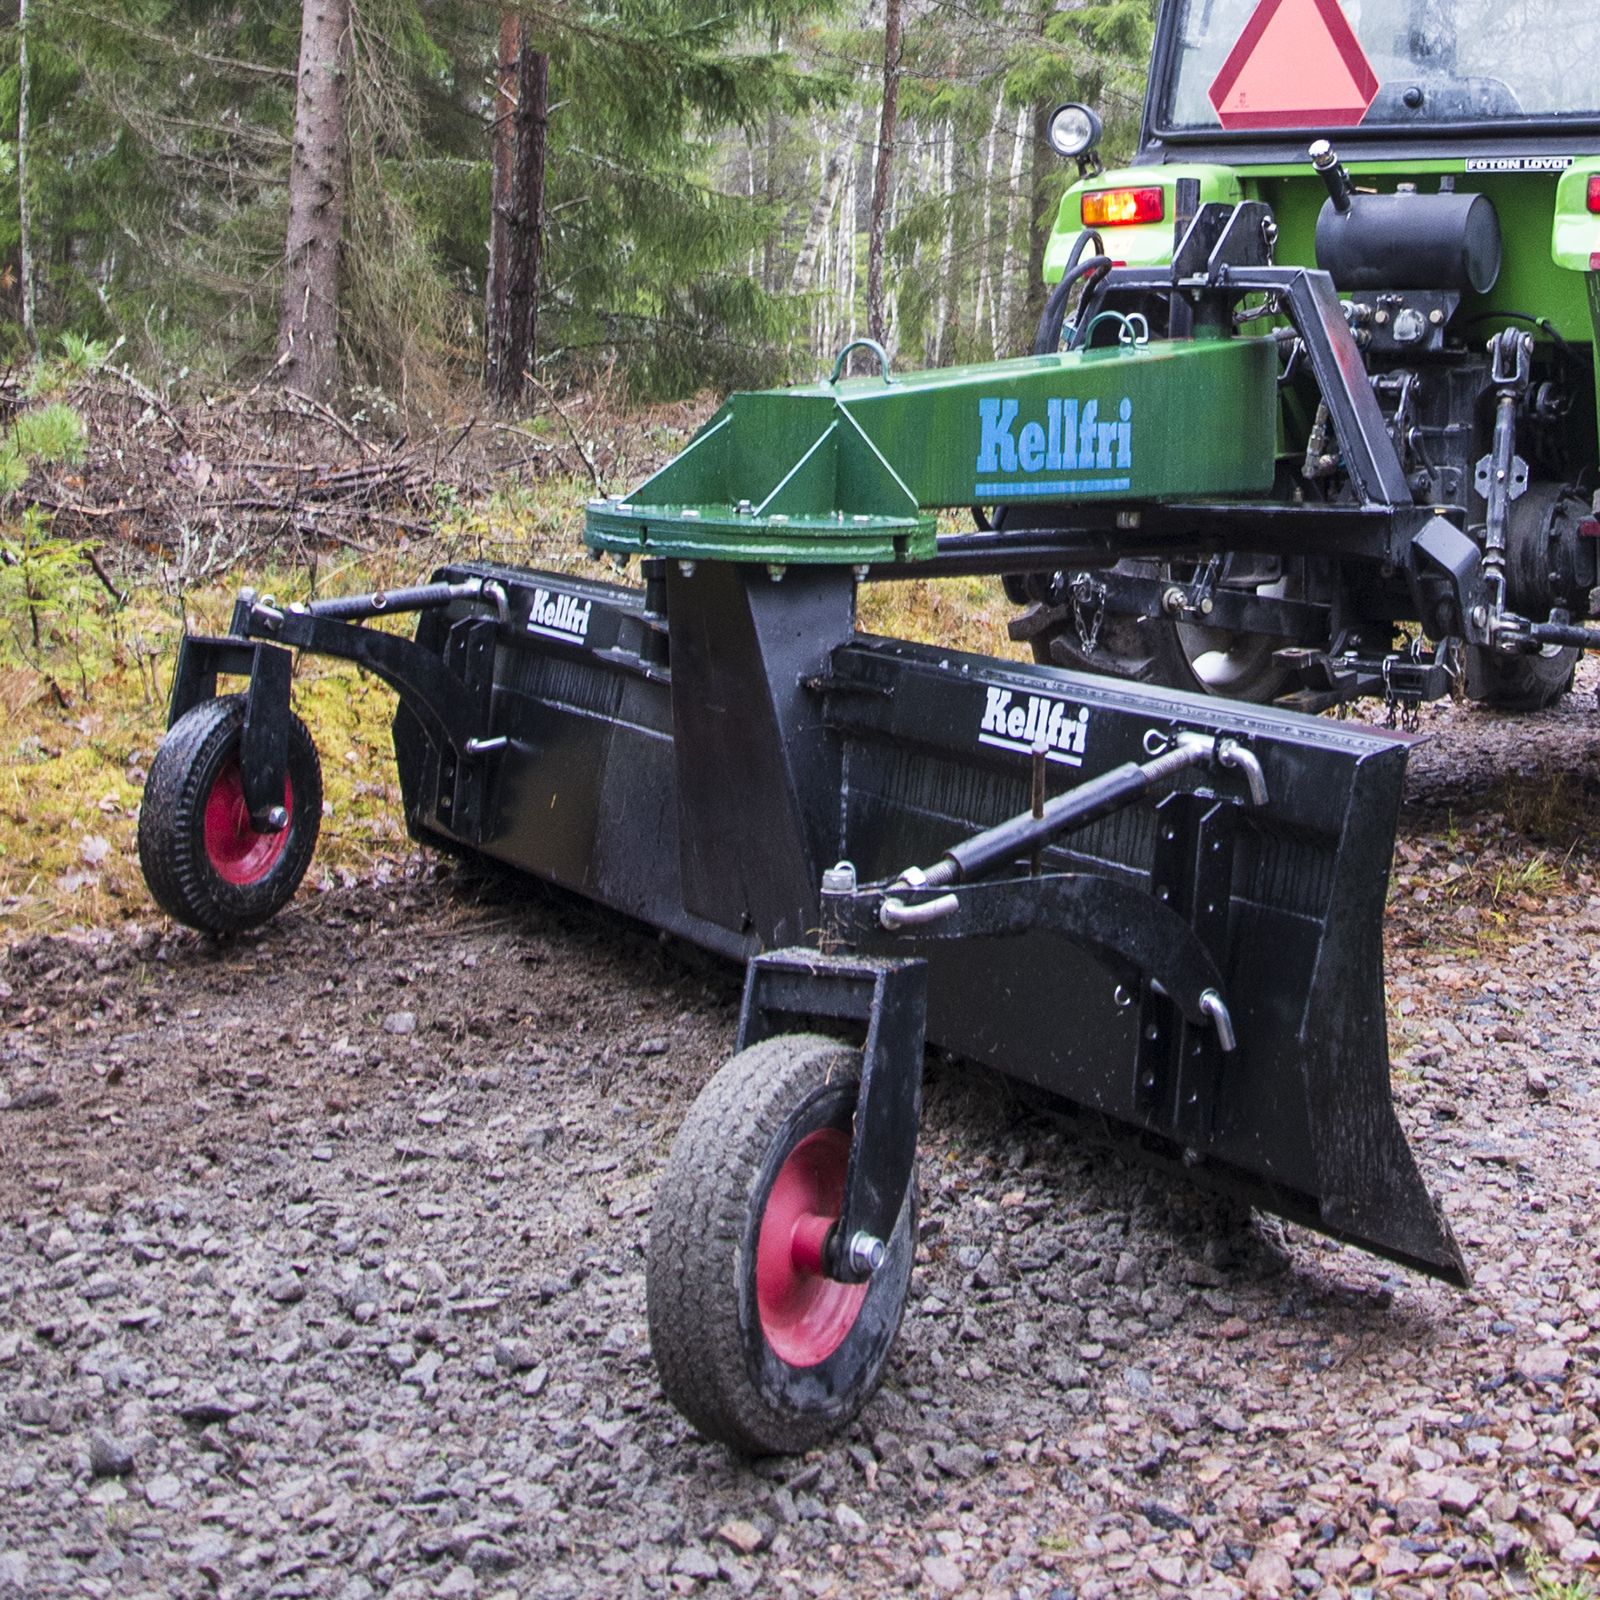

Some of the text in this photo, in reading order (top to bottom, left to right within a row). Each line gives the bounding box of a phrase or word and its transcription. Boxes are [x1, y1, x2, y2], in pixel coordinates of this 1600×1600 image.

[1468, 160, 1520, 170] FOTON
[976, 397, 1132, 473] Kellfri
[529, 588, 592, 635] Kellfri
[981, 686, 1089, 753] Kellfri
